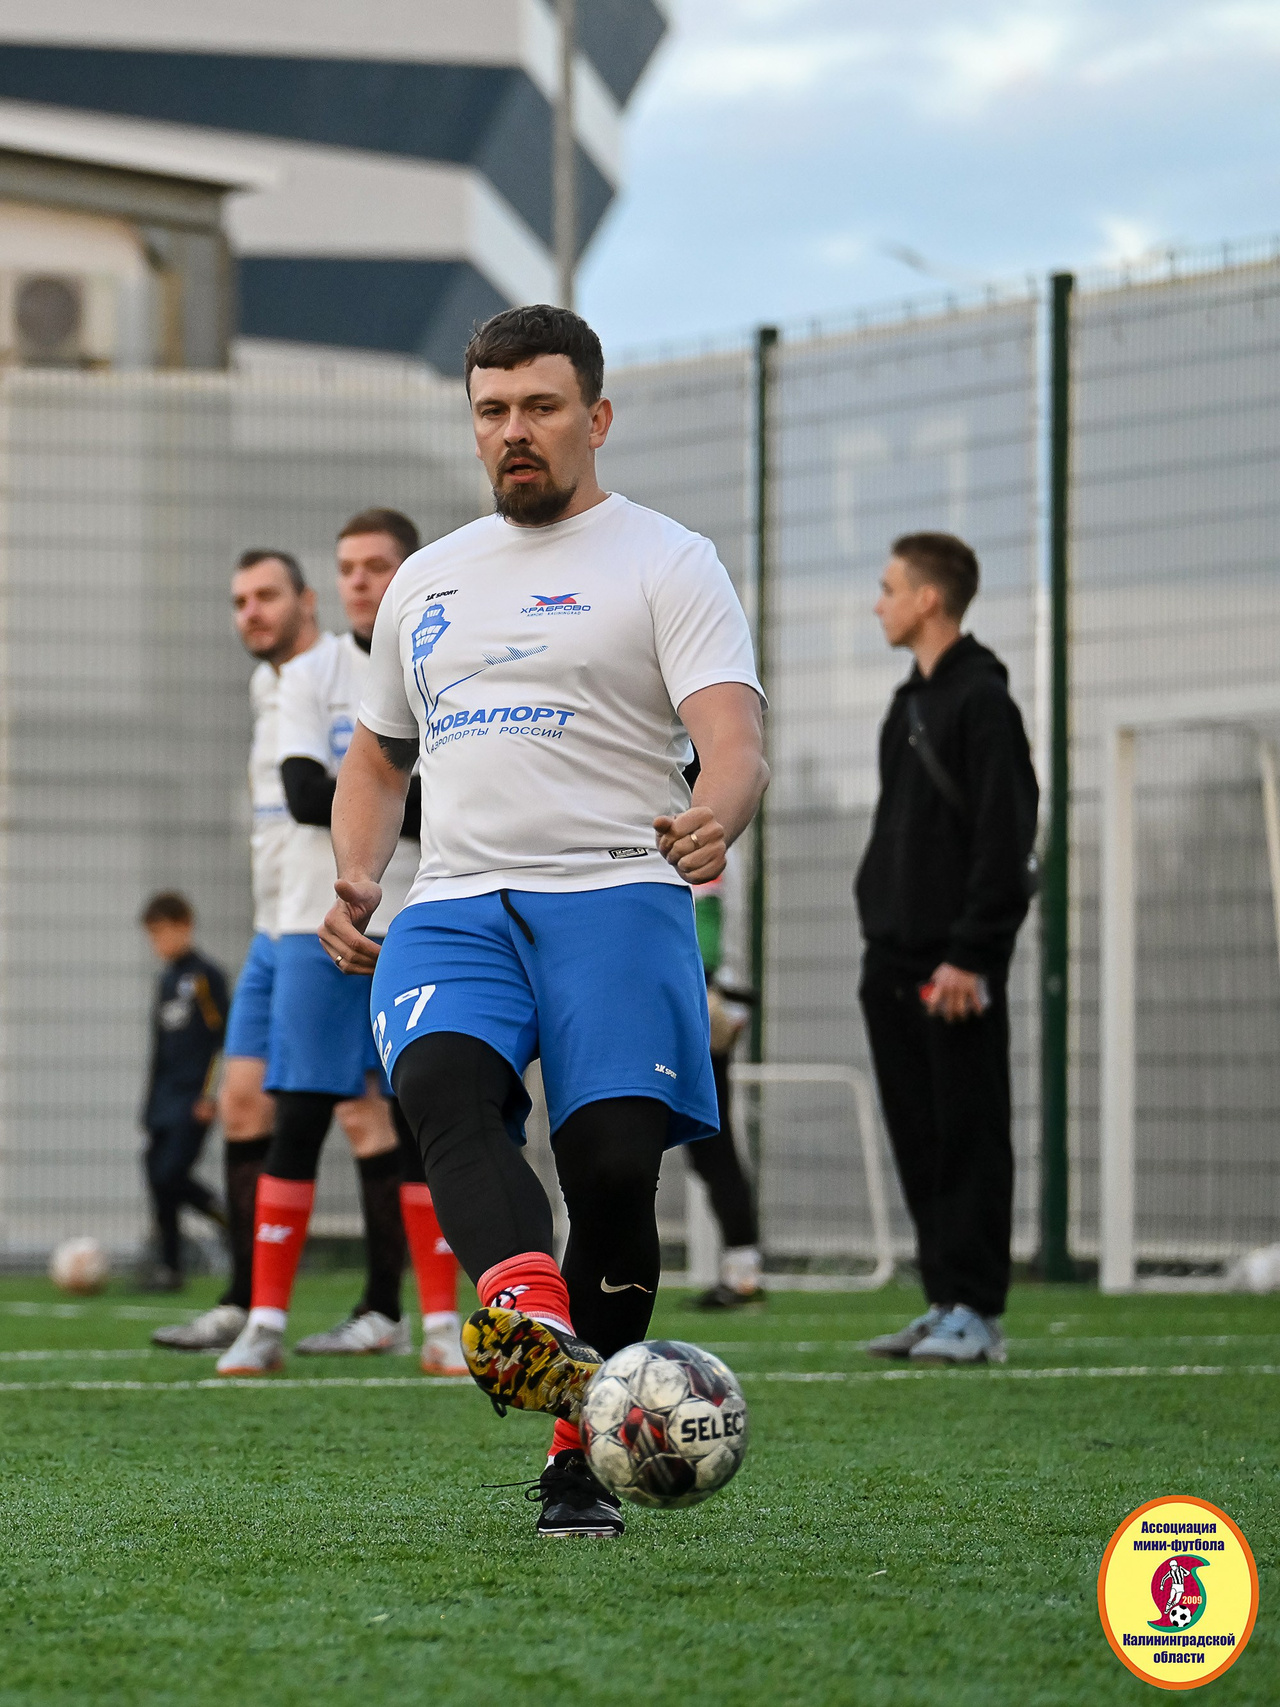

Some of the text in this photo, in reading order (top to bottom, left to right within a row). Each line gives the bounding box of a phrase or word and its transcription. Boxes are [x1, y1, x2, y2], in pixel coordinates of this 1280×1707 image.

[520, 605, 592, 614] ХРАБРОВО
[431, 706, 575, 739] НОВАПОРТ
[430, 726, 563, 754] АЭРОПОРТЫ РОССИИ
[681, 1411, 745, 1443] SELEC
